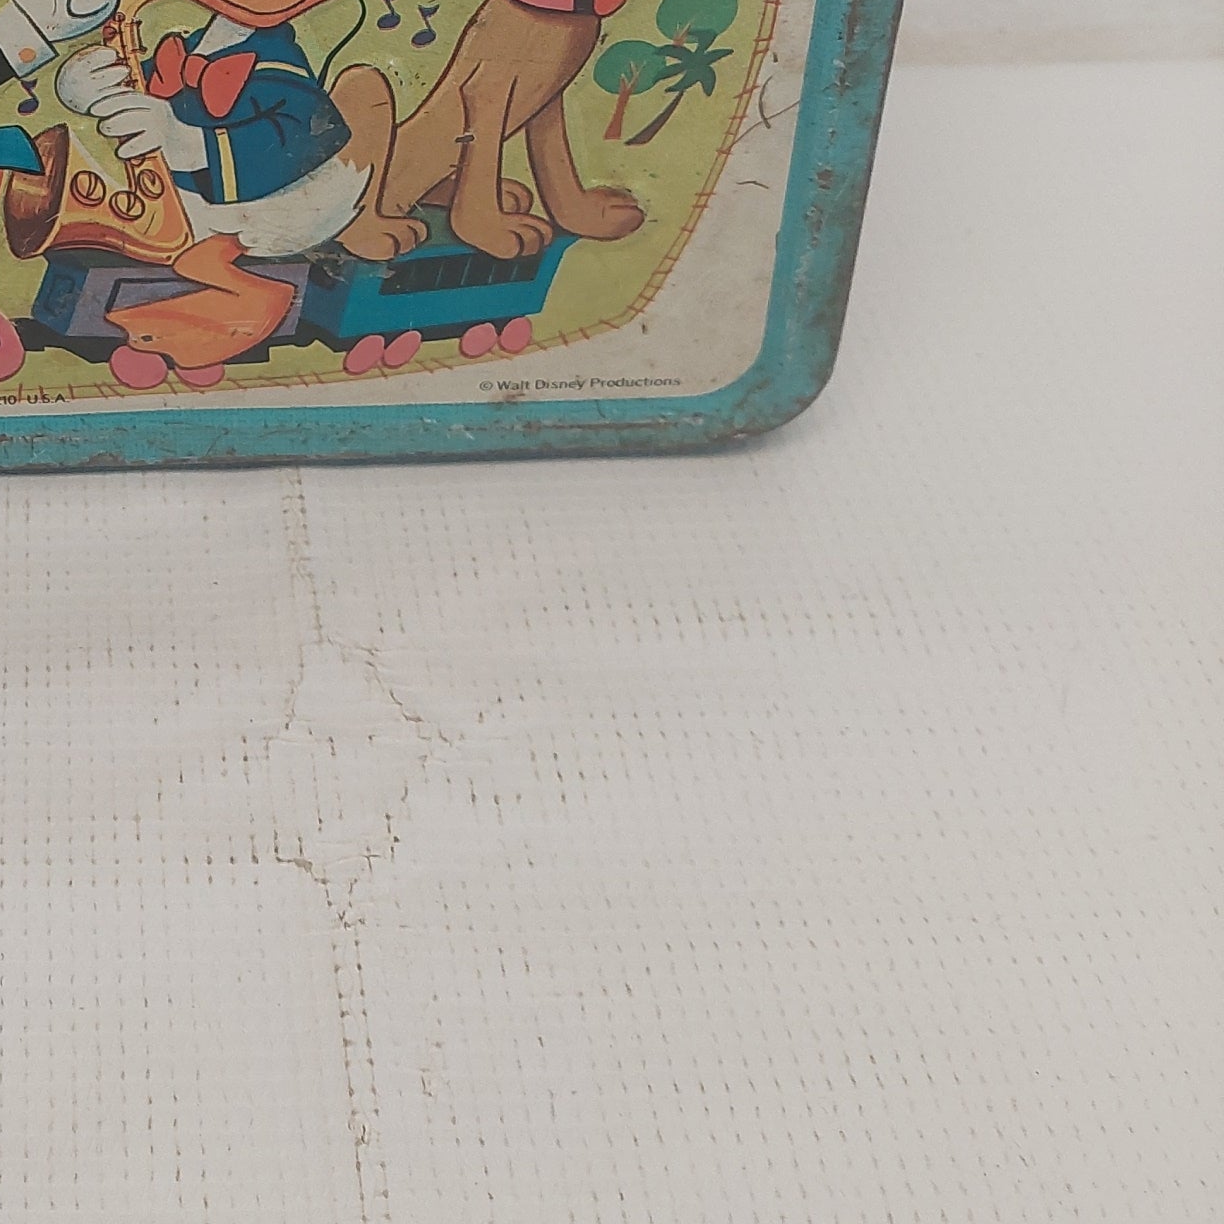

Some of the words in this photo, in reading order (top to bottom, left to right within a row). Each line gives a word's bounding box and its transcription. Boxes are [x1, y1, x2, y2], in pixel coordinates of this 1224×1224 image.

[496, 379, 530, 391] Walt
[534, 378, 586, 391] Disney
[589, 376, 682, 388] Productions
